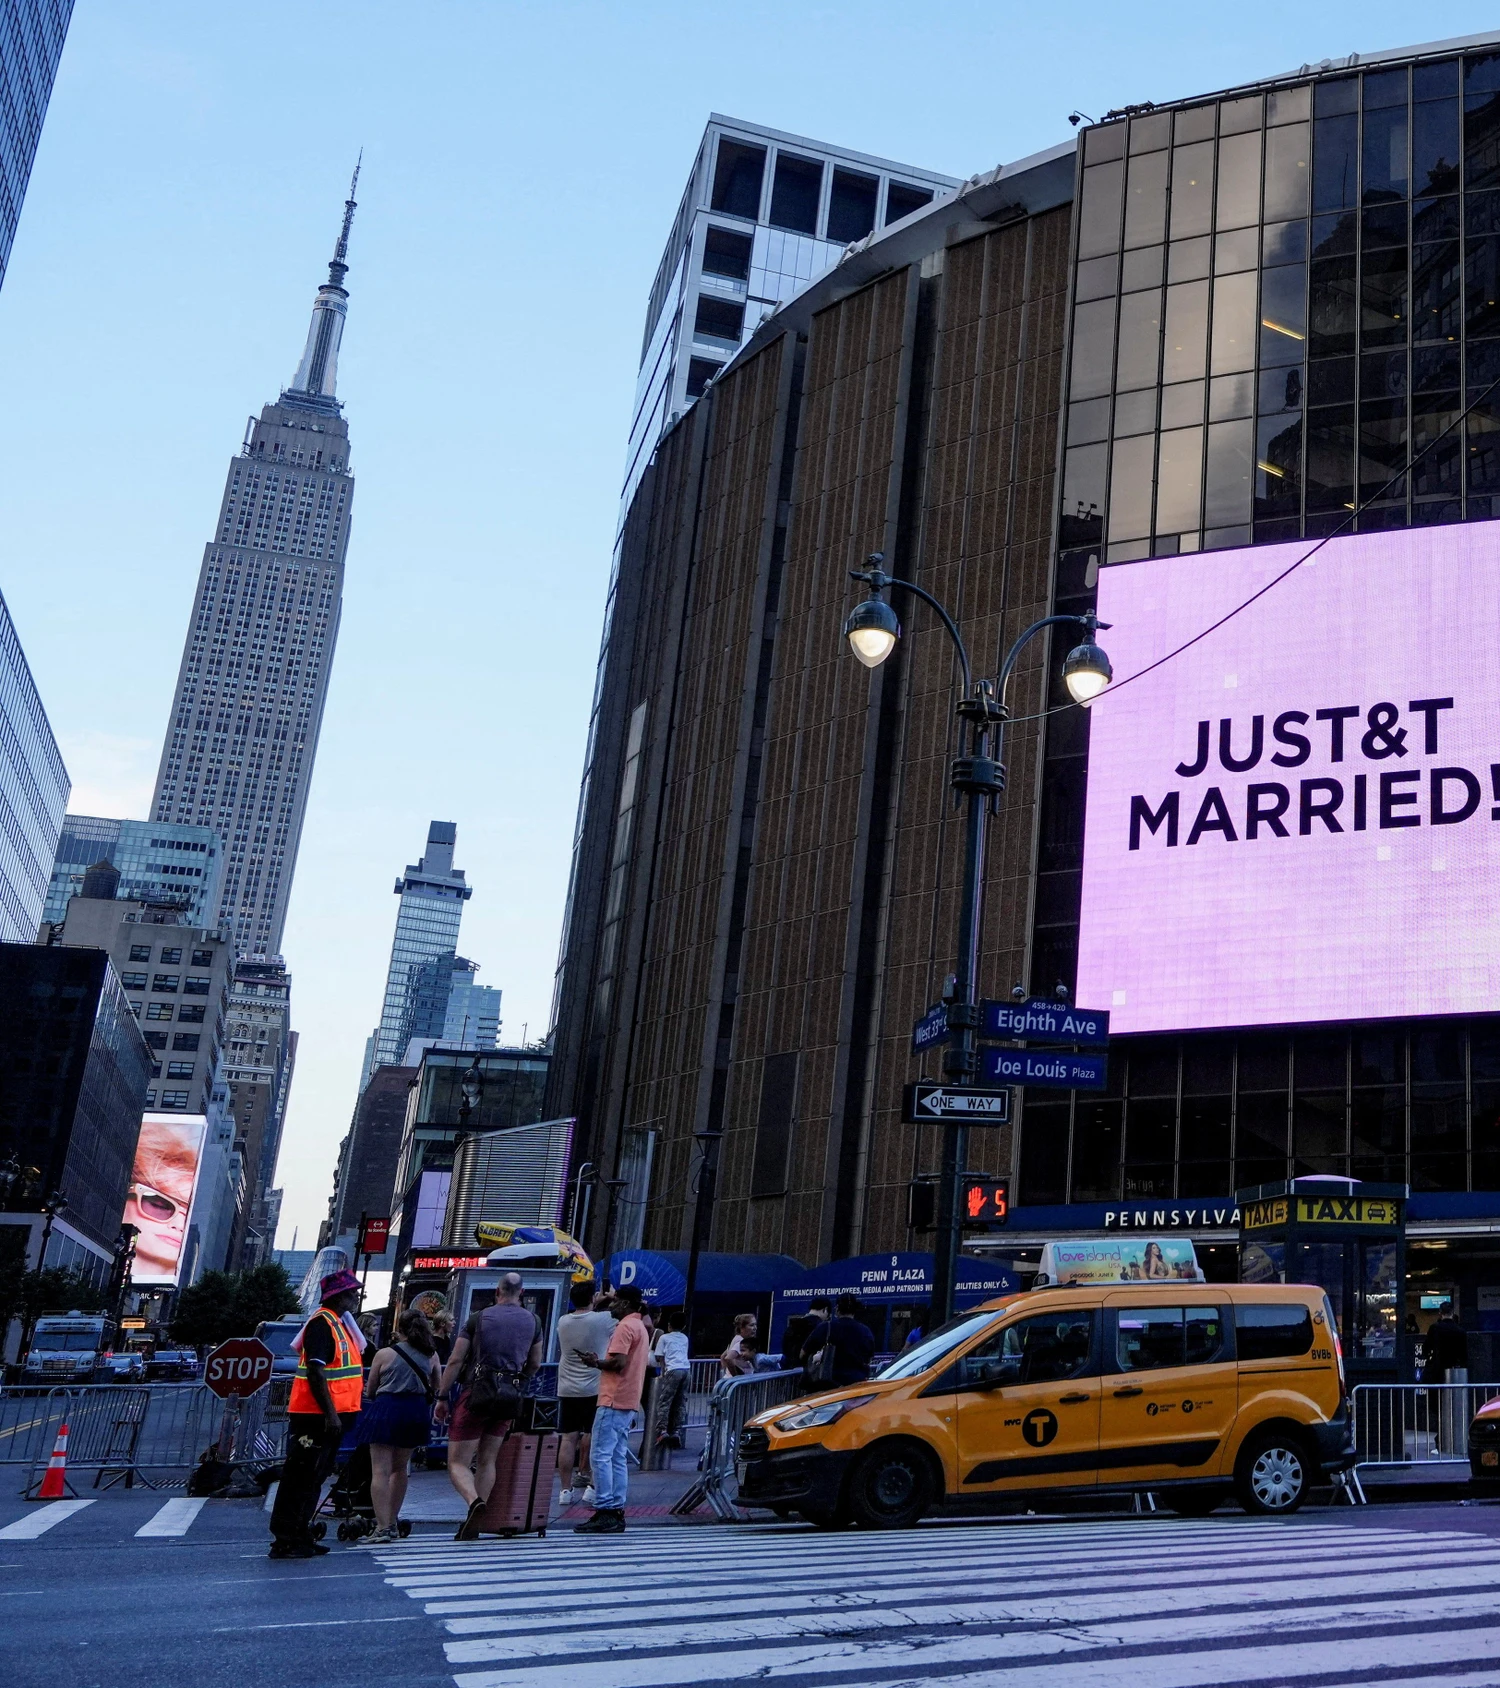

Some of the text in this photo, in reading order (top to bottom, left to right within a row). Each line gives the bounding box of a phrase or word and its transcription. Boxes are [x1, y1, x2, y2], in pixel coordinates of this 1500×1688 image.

[1175, 697, 1453, 777] JUST&T
[997, 1009, 1097, 1035] Eighth Ave
[915, 1023, 932, 1044] West
[994, 1057, 1096, 1079] Joe Louis Plaza
[930, 1096, 994, 1110] ONE WAY
[994, 1189, 1006, 1216] 5
[1302, 1200, 1363, 1221] TAXI
[1105, 1208, 1240, 1227] PENNSYLVA
[1246, 1201, 1273, 1227] TAXI
[892, 1256, 897, 1266] 8
[1057, 1245, 1121, 1262] love island
[620, 1261, 636, 1285] D
[861, 1268, 925, 1283] PENN PLAZA
[783, 1289, 813, 1297] ENTRANCE
[814, 1288, 826, 1296] FOR
[863, 1286, 881, 1294] MEDIA
[896, 1284, 924, 1293] PATRONS
[983, 1280, 1000, 1290] ONLY
[209, 1356, 269, 1381] STOP
[1004, 1418, 1021, 1427] NYC
